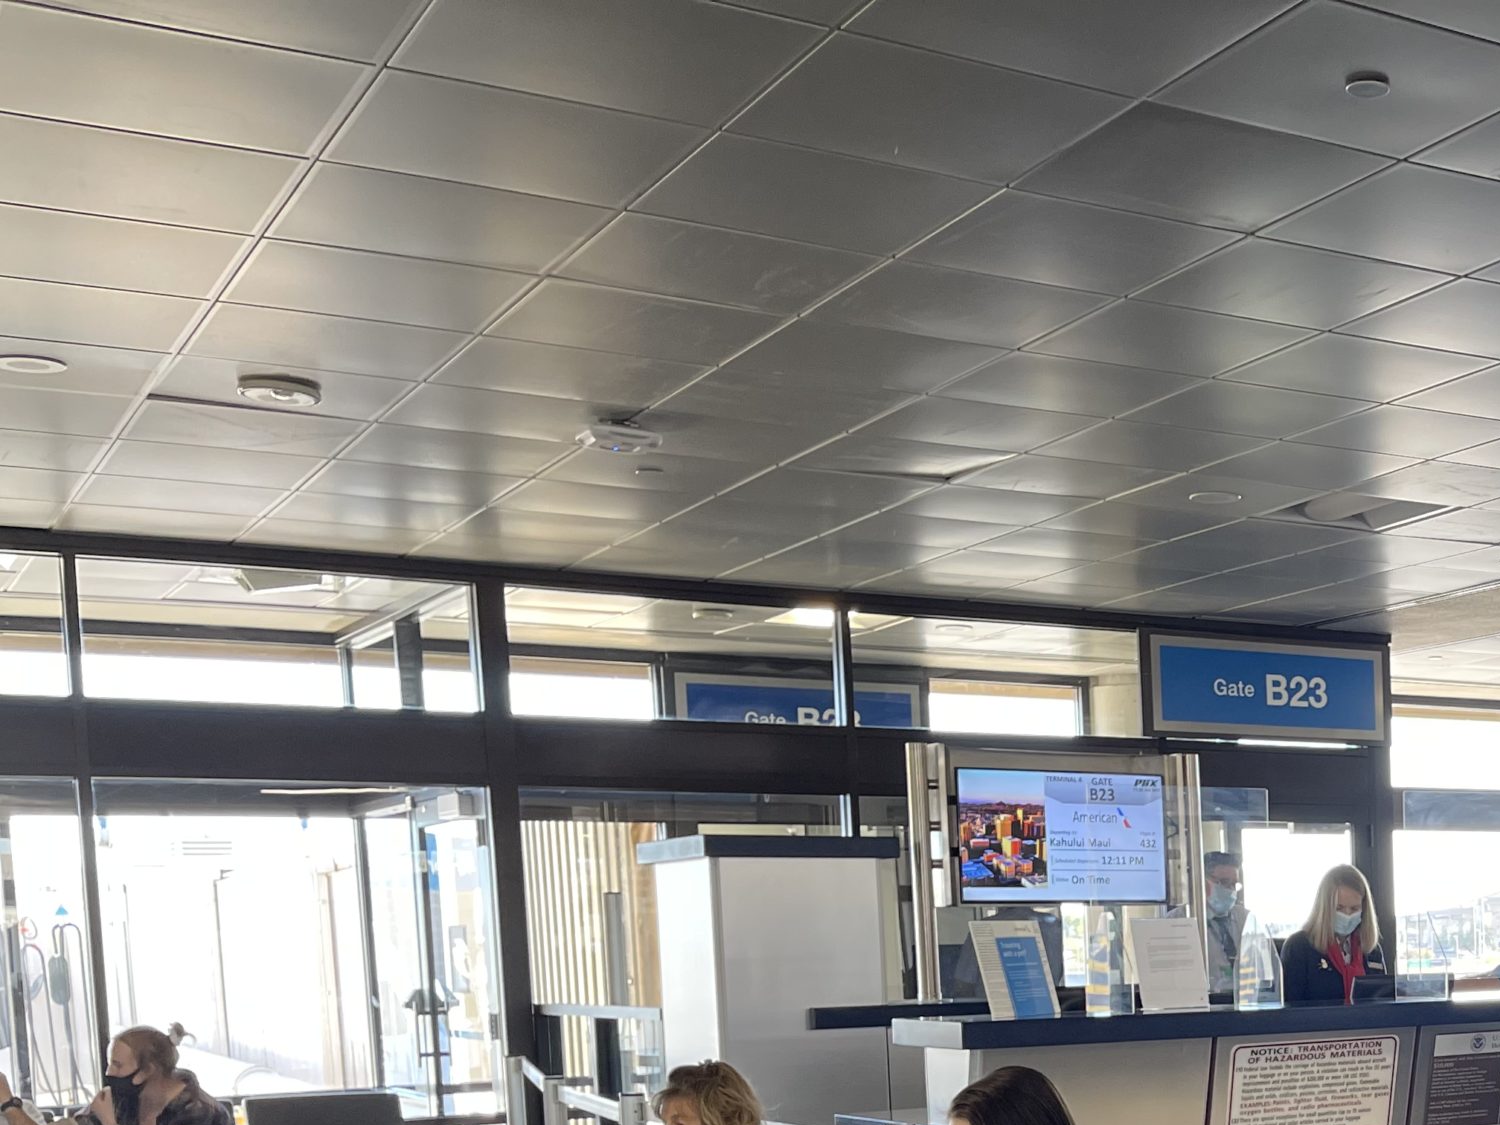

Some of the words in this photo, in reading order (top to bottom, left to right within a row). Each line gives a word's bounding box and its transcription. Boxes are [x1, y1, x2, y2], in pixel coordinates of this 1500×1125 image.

[1213, 678, 1255, 698] Gate
[1265, 673, 1328, 709] B23
[1046, 776, 1077, 784] TERMINAL
[1091, 777, 1113, 787] GATE
[1090, 787, 1115, 802] B23
[1072, 811, 1118, 824] American
[1050, 837, 1085, 847] Kahului
[1088, 838, 1111, 848] Maui
[1139, 839, 1157, 848] 432
[1101, 856, 1127, 865] 12:11
[1129, 856, 1144, 865] PM
[1071, 875, 1085, 885] On
[1087, 875, 1110, 885] Time
[1250, 1047, 1294, 1057] NOTICE:
[1297, 1041, 1383, 1054] TRANSPORTATION
[1247, 1055, 1260, 1065] OF
[1264, 1052, 1327, 1064] HAZARDOUS
[1329, 1048, 1383, 1059] MATERIALS
